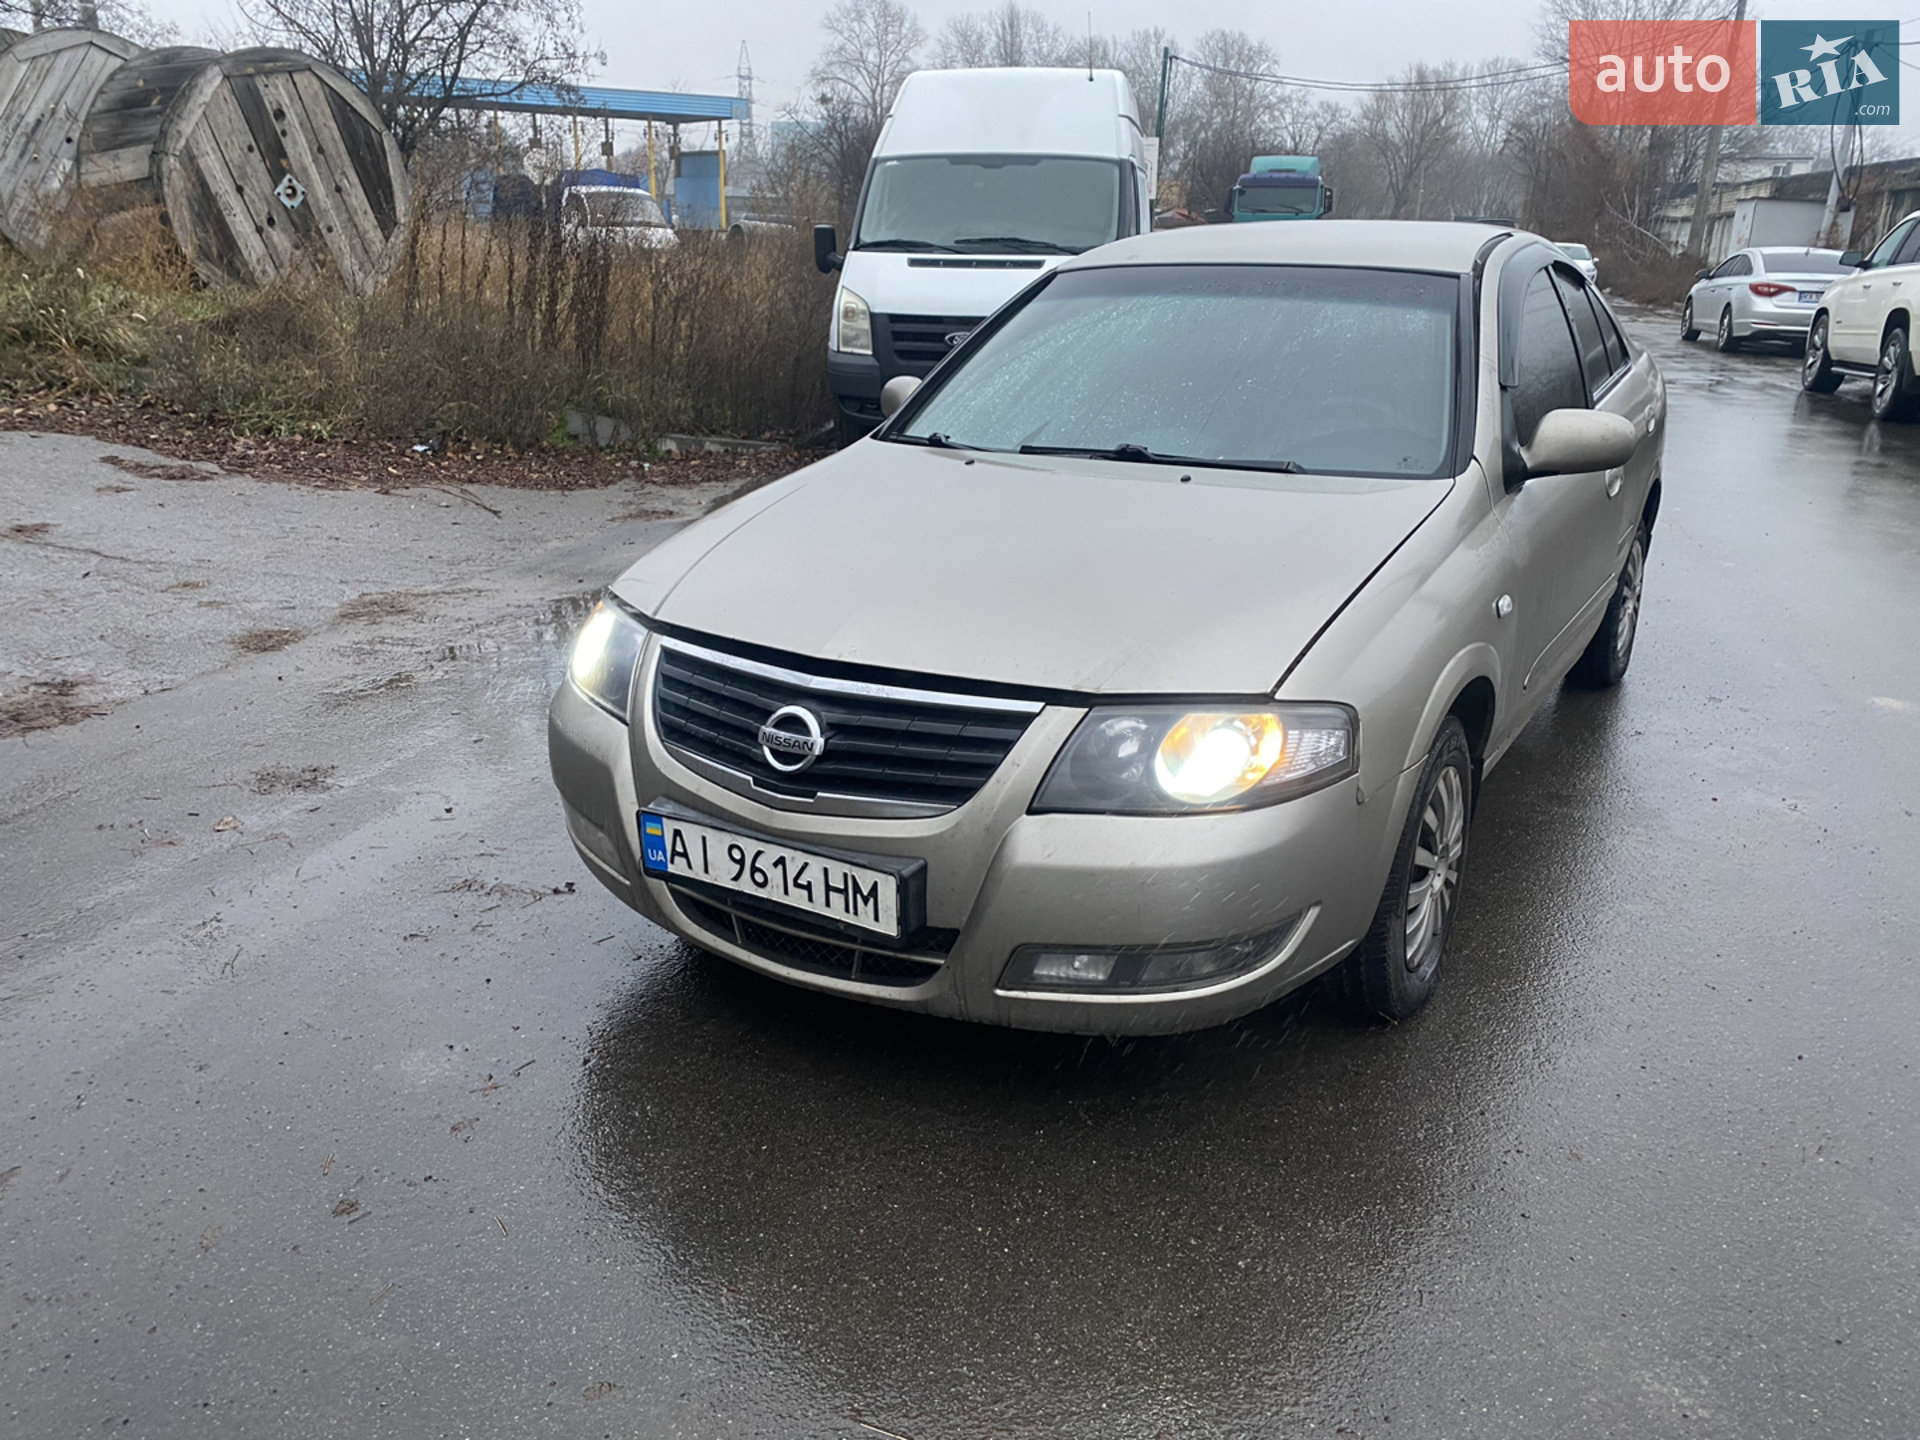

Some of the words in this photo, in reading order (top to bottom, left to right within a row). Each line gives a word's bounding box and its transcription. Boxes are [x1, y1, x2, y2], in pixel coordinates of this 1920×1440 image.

[762, 731, 814, 752] NISSAN
[647, 848, 666, 863] UA
[670, 828, 709, 874] AI
[727, 843, 813, 903] 9614
[823, 866, 880, 923] HM
